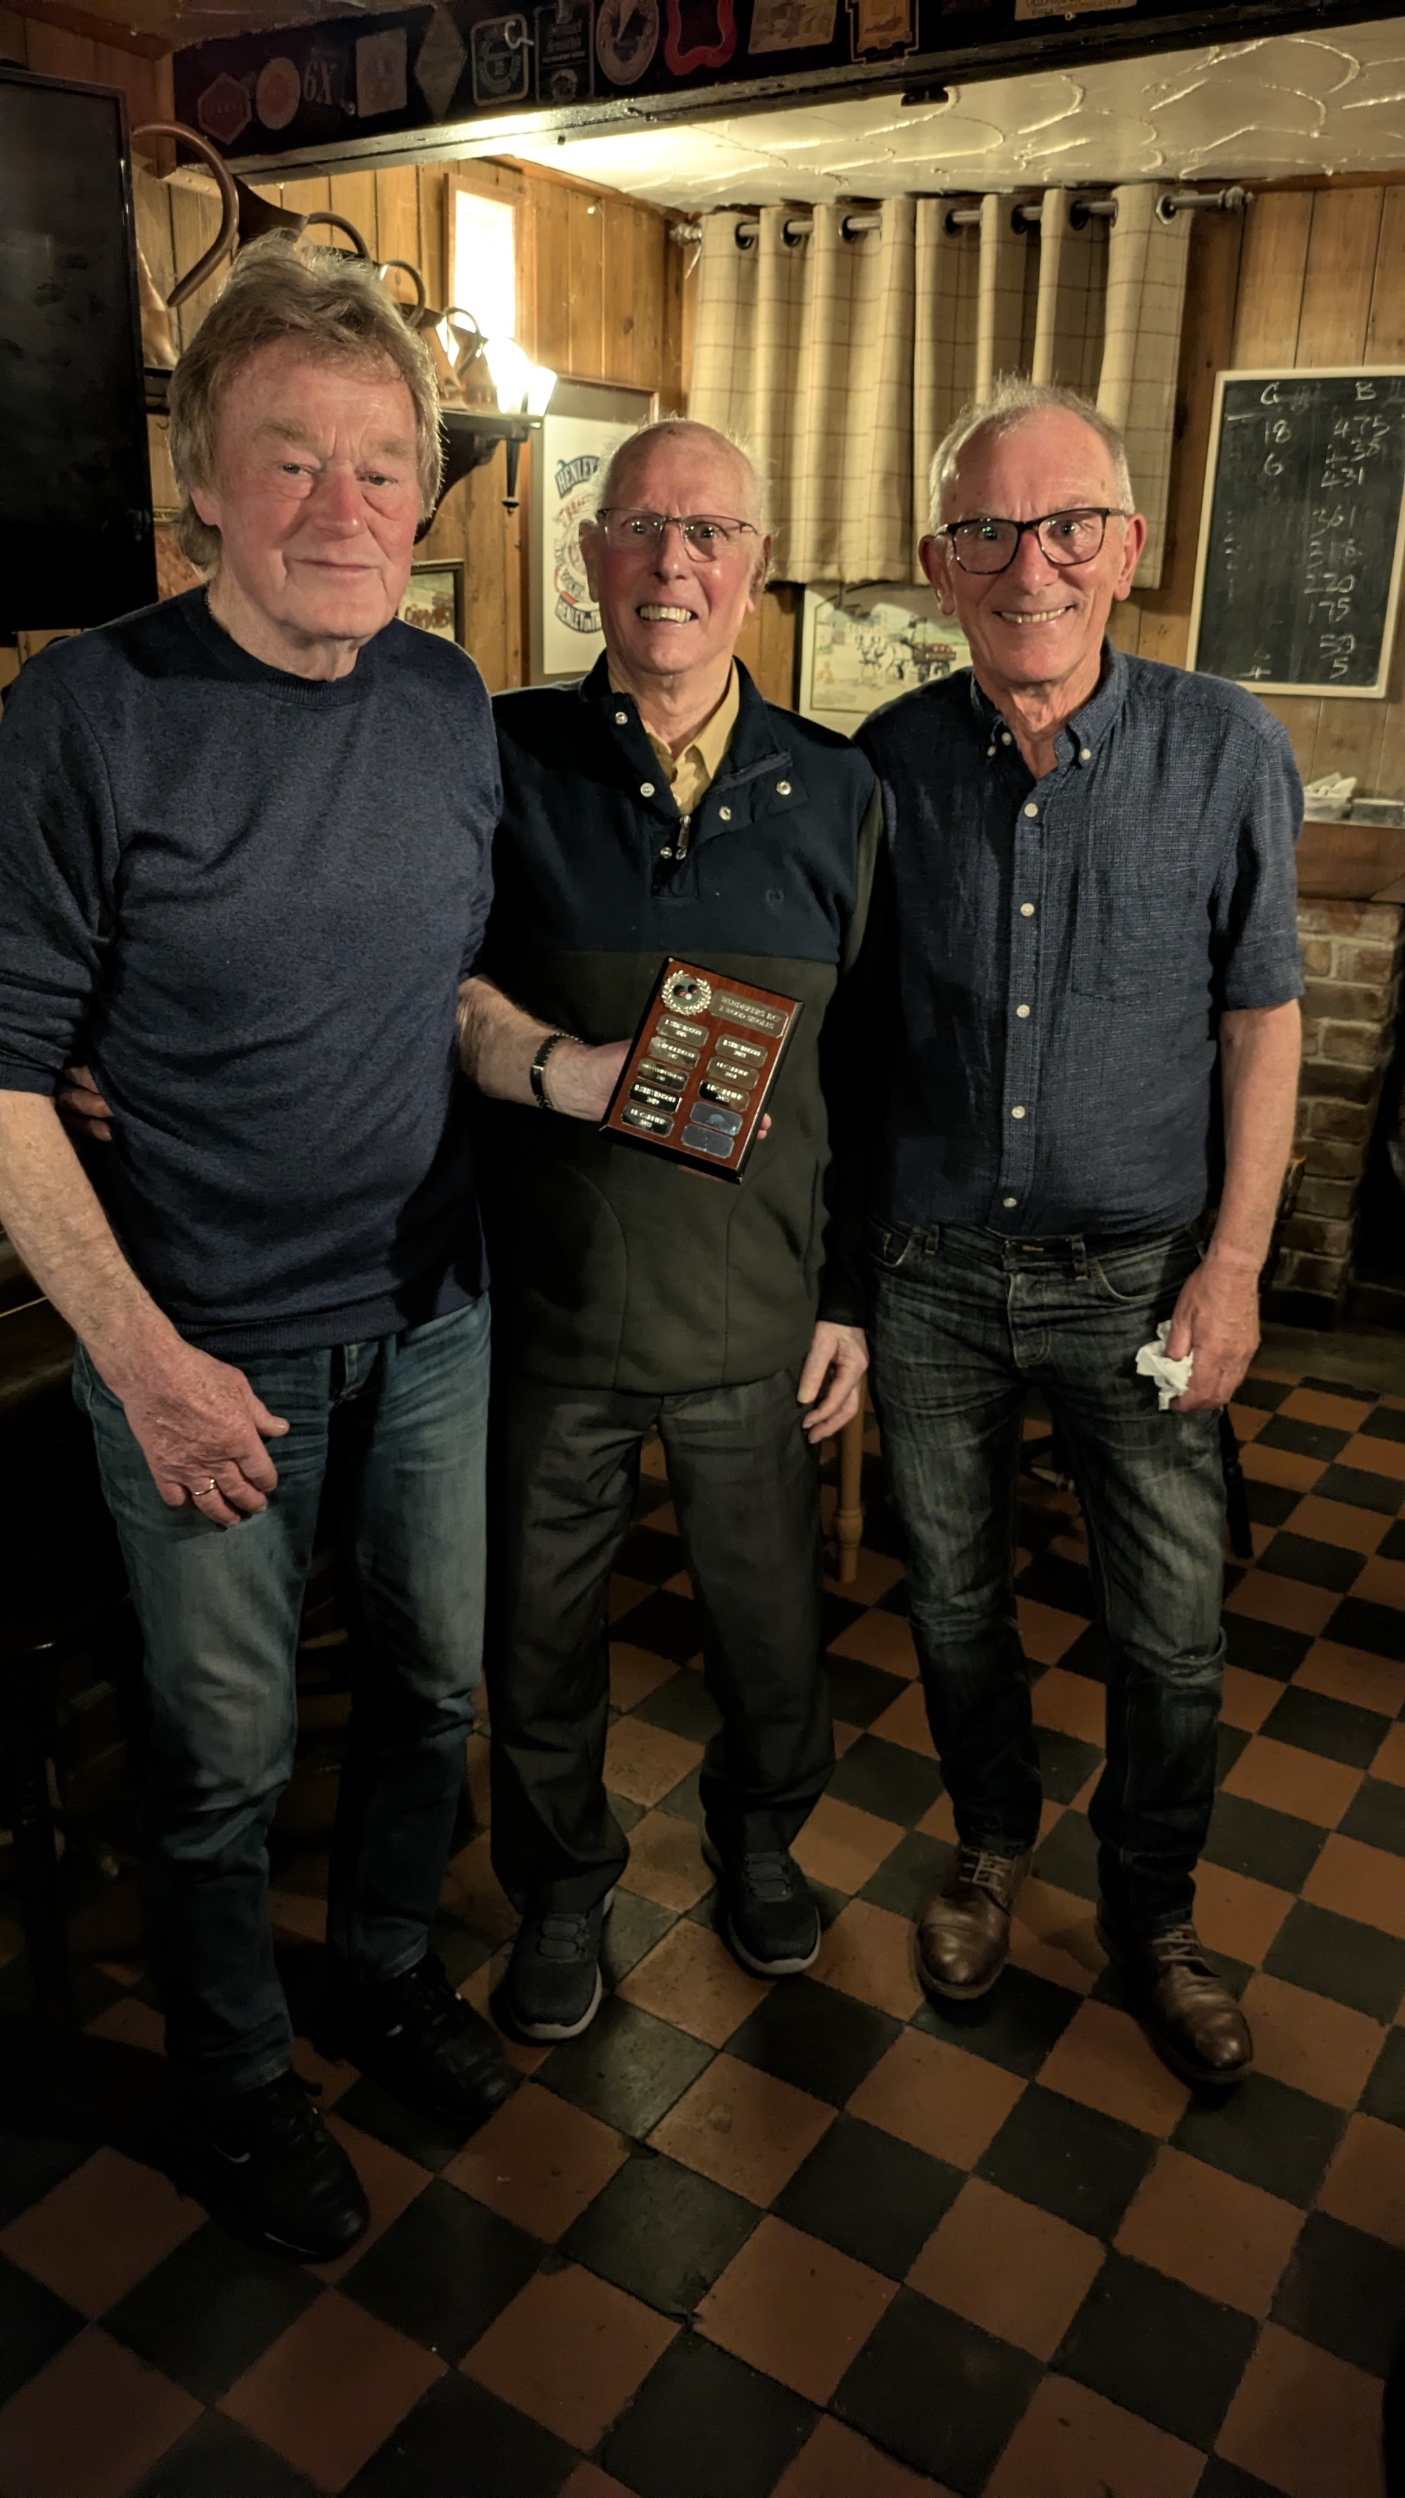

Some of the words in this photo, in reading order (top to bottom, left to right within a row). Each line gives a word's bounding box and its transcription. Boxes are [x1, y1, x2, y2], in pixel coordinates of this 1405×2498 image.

[1264, 419, 1292, 444] 18
[1333, 415, 1391, 438] 475
[1263, 452, 1284, 477] 6
[1320, 466, 1365, 490] 431
[1303, 572, 1356, 594] 220
[1308, 598, 1352, 625] 175
[1329, 657, 1350, 680] 5
